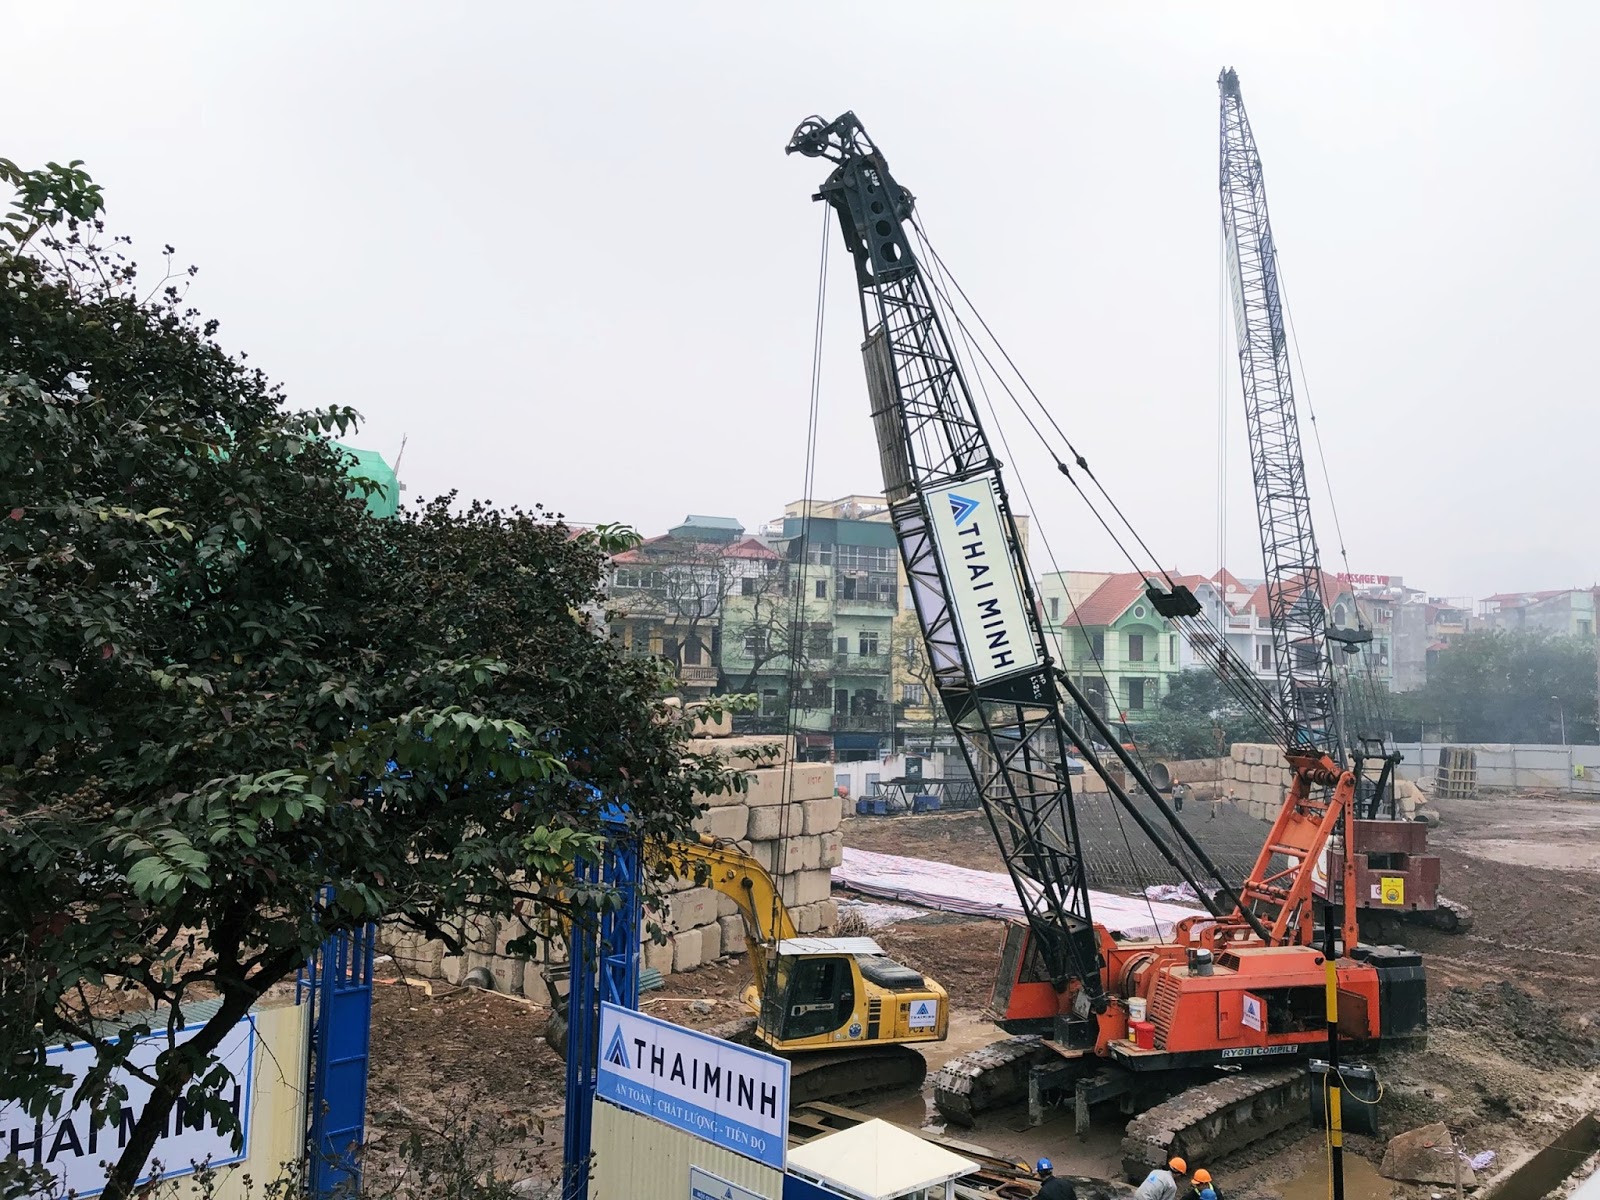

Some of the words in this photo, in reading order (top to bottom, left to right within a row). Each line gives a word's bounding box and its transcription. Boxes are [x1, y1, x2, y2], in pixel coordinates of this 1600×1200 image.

[1336, 573, 1376, 585] MASSAGE
[1256, 1045, 1297, 1055] COMPILE
[634, 1037, 777, 1119] THAIMINH
[615, 1082, 627, 1096] AN
[0, 1106, 98, 1164] HAI
